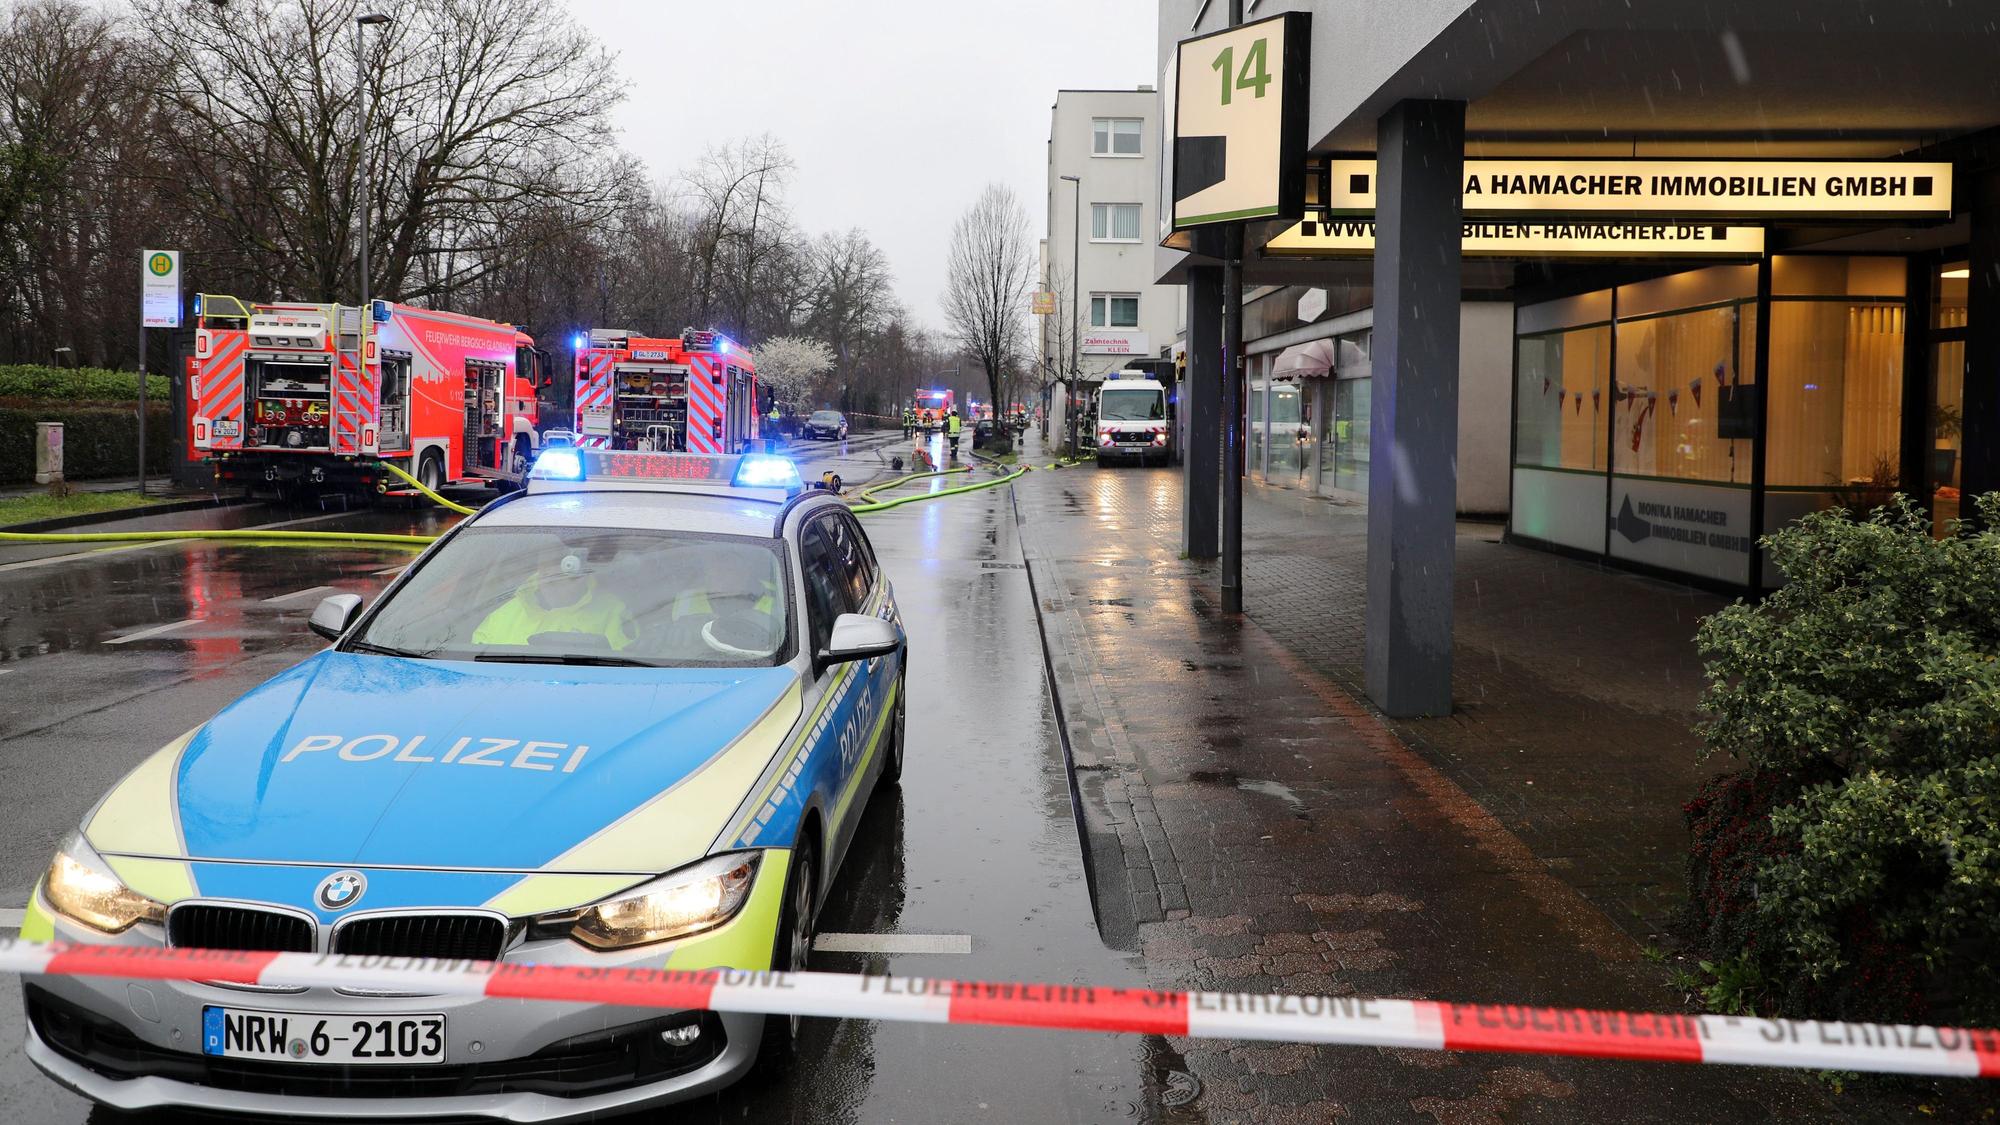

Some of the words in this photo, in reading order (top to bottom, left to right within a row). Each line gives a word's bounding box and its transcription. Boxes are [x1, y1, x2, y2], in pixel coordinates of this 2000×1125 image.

[1212, 38, 1271, 106] 14
[1491, 175, 1643, 195] HAMACHER
[1651, 176, 1816, 196] IMMOBILIEN
[1825, 176, 1907, 196] GMBH
[425, 330, 460, 347] FEUERWEHR
[460, 335, 486, 350] BERGISCH
[486, 340, 512, 353] GLADBACH
[1638, 502, 1671, 519] MONIKA
[1674, 507, 1727, 527] HAMACHER
[1652, 524, 1707, 546] IMMOBILIEN
[1709, 532, 1740, 552] GMBH
[840, 683, 872, 779] POLIZEI
[281, 734, 590, 773] POLIZEI
[224, 1013, 289, 1054] NRW
[310, 1019, 443, 1058] 6-2103
